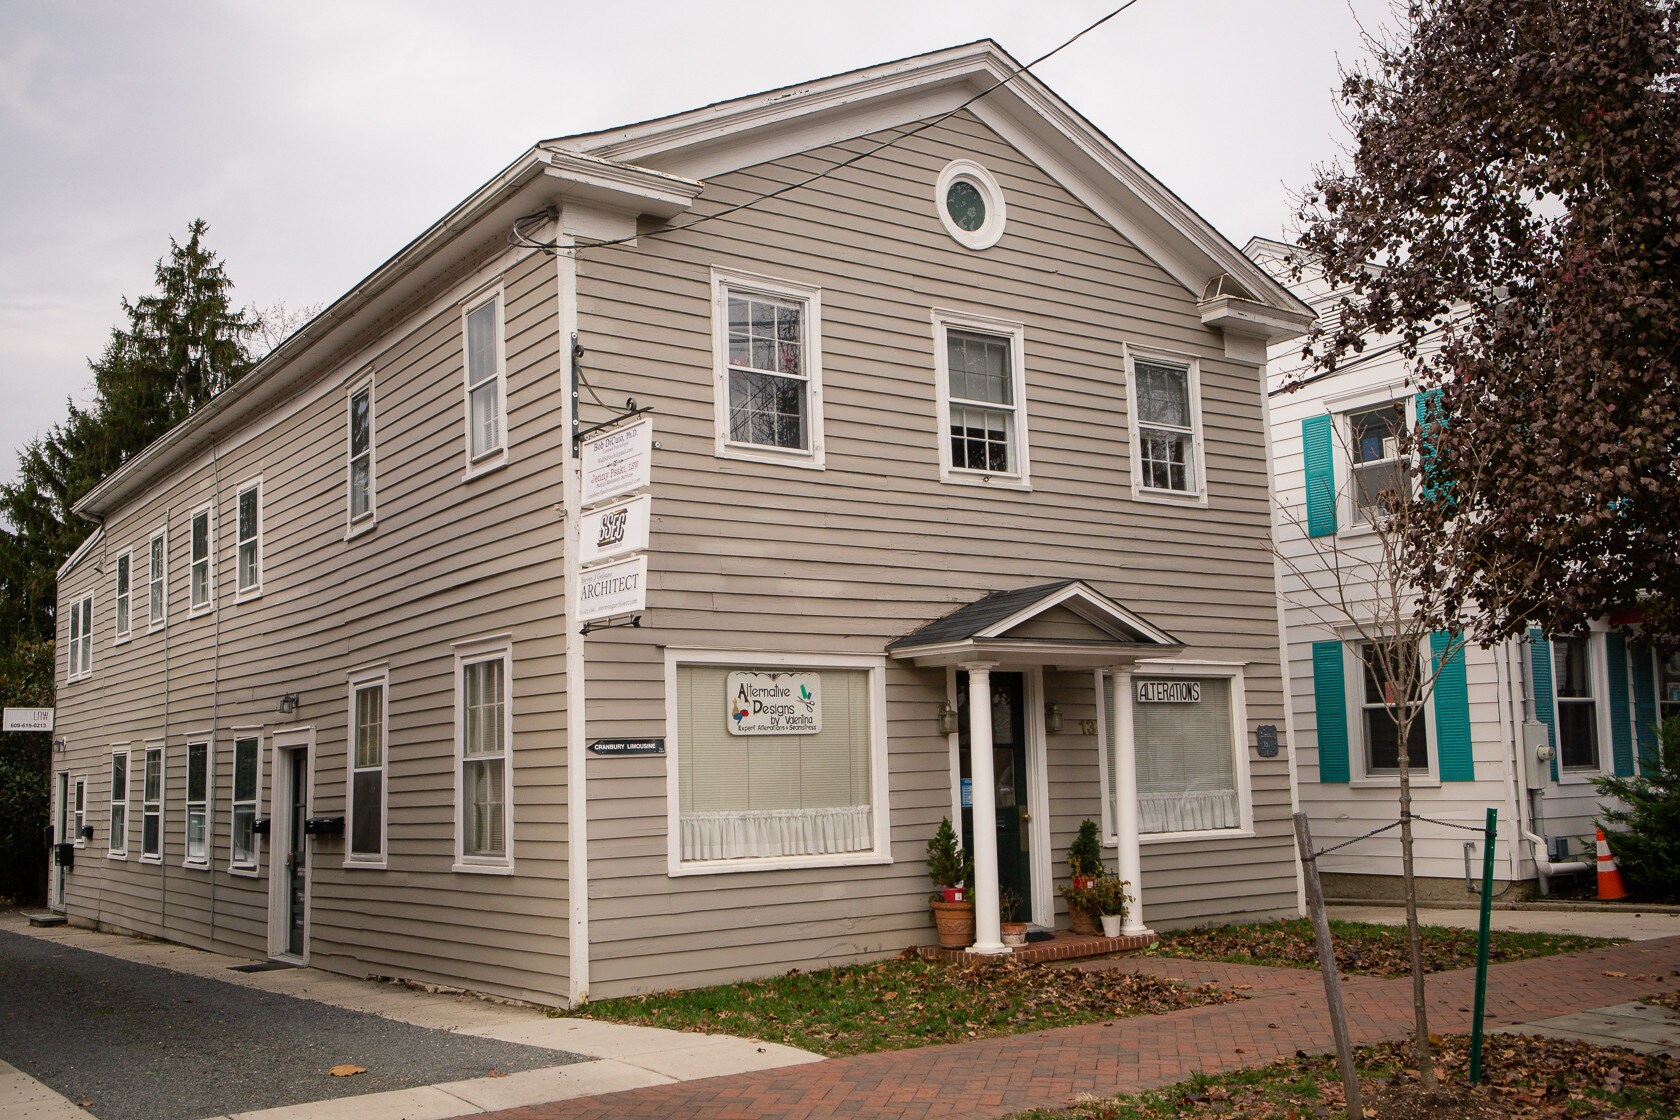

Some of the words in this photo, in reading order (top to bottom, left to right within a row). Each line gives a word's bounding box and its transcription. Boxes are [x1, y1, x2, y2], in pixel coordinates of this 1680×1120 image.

[593, 440, 604, 452] Bob
[591, 472, 609, 484] Jenny
[599, 511, 627, 542] SSEC
[580, 573, 639, 600] ARCHITECT
[738, 683, 790, 703] Alternative
[1139, 682, 1200, 701] ALTERATIONS
[33, 711, 49, 721] LAW
[752, 700, 795, 716] Designs
[770, 715, 780, 725] by
[785, 714, 813, 725] Valentina
